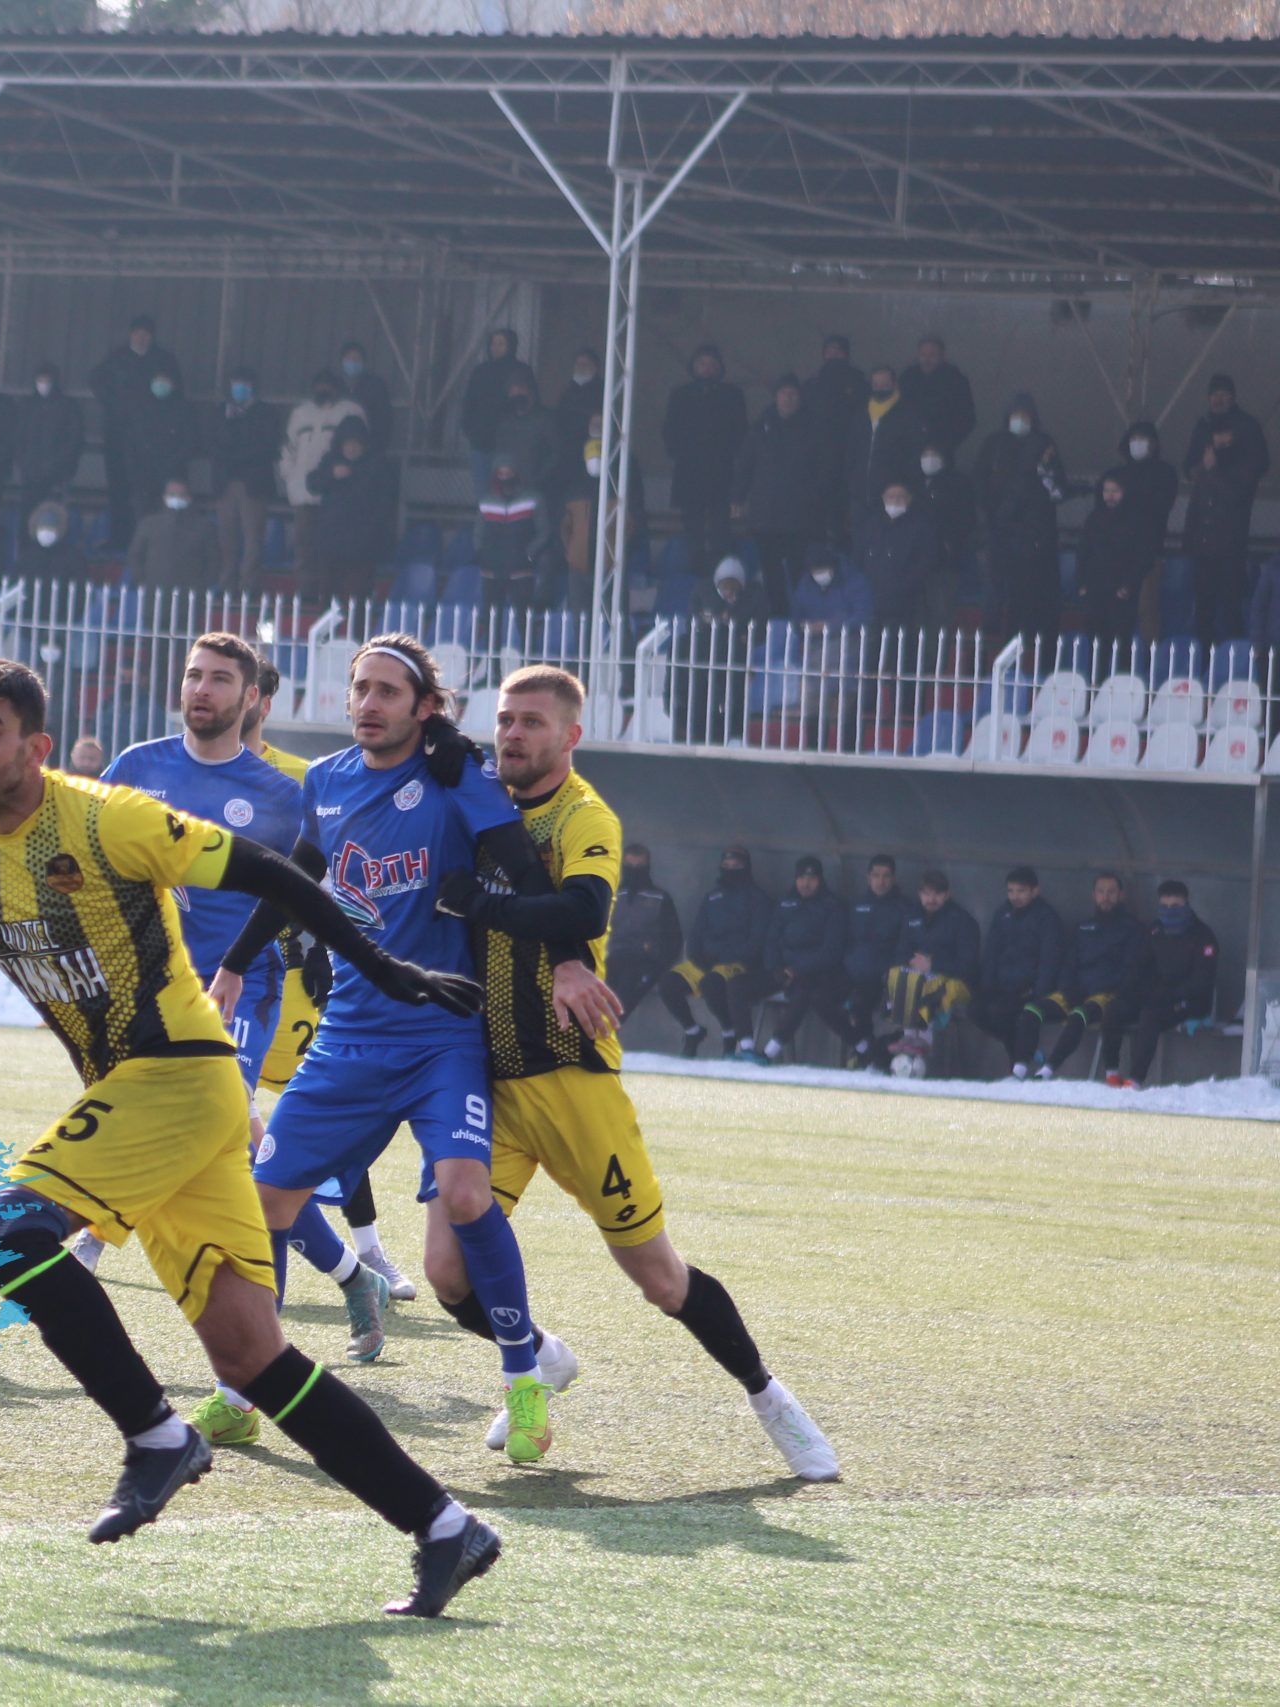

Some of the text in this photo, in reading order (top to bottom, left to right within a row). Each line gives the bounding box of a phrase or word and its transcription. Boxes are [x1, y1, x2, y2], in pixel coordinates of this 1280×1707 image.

[362, 847, 428, 890] BTH
[0, 920, 60, 951] HOTEL
[232, 1016, 250, 1048] 11
[291, 1020, 318, 1056] 2
[56, 1098, 114, 1142] 5
[465, 1094, 487, 1130] 9
[601, 1153, 632, 1199] 4
